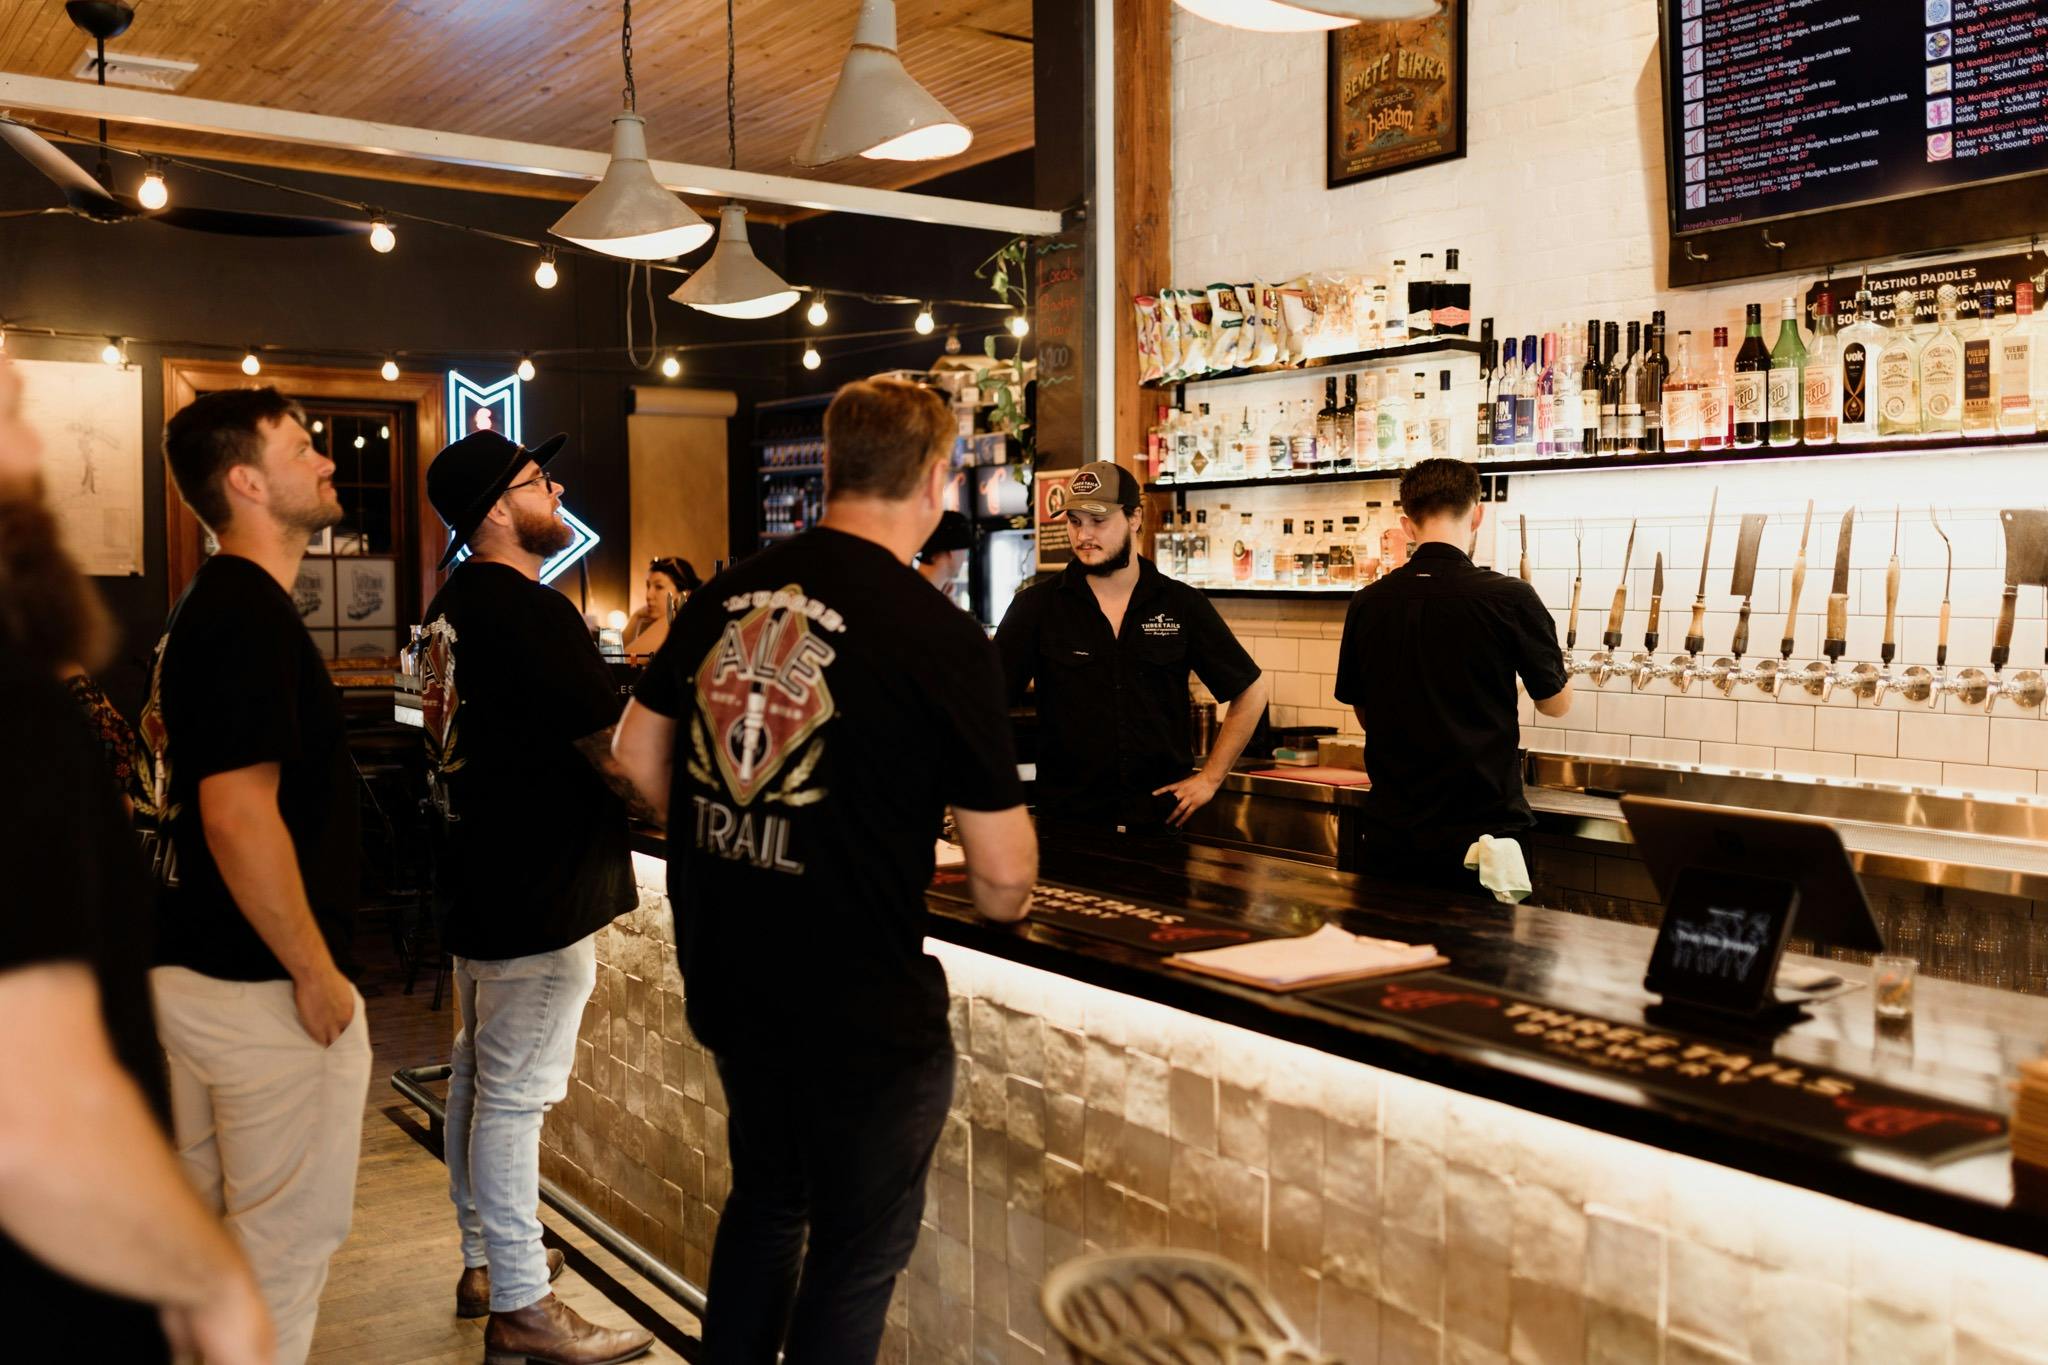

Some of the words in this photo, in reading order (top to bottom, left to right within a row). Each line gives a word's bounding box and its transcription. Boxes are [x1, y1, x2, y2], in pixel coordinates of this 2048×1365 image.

[1955, 2, 1967, 11] IPA
[1955, 9, 1977, 20] Middy
[1979, 6, 1988, 15] $9
[1993, 0, 2028, 11] Schooner
[1787, 28, 1810, 38] Mudgee,
[1811, 24, 1824, 32] New
[1824, 19, 1841, 28] South
[1842, 15, 1860, 23] Wales
[1955, 27, 1965, 35] 18.
[1967, 23, 1985, 33] Bach
[2011, 12, 2036, 22] Marley
[1955, 35, 1974, 45] Stout
[1981, 28, 2005, 39] cherry
[2006, 24, 2024, 33] choc
[1955, 44, 1977, 54] Middy
[1979, 40, 1990, 50] $11
[1996, 32, 2031, 45] Schooner
[2034, 28, 2047, 37] $14
[1397, 49, 1446, 80] BIRRA
[1778, 59, 1801, 68] Mudgee,
[1815, 50, 1832, 60] South
[1833, 47, 1851, 55] Wales
[1955, 62, 1965, 70] 19.
[1966, 56, 1993, 67] Nomad
[2024, 47, 2038, 55] Day
[1955, 69, 1974, 79] Stout
[1980, 61, 2010, 73] Imperial
[2018, 54, 2044, 65] Double
[1955, 78, 1977, 88] Middy
[1979, 75, 1988, 84] $9
[1994, 68, 2029, 80] Schooner
[2031, 63, 2044, 73] $12
[1765, 91, 1787, 100] Mudgee,
[1801, 83, 1818, 92] South
[1819, 80, 1836, 88] Wales
[1956, 96, 1966, 105] 20.
[1968, 87, 2015, 101] Morningcider
[1832, 105, 1856, 114] Mudgee,
[1871, 97, 1889, 106] South
[1889, 93, 1907, 102] Wales
[1955, 105, 1974, 114] Cider
[2006, 94, 2023, 104] 4.9%
[2025, 91, 2040, 100] ABV
[1955, 113, 1978, 123] Middy
[1979, 108, 1998, 119] $9.50
[2004, 101, 2039, 113] Schooner
[1367, 103, 1414, 141] baladin
[1956, 131, 1965, 139] 21.
[1967, 125, 1993, 136] Nomad
[1994, 121, 2015, 131] Good
[1790, 144, 1801, 152] ABV
[1805, 140, 1828, 149] Mudgee,
[1843, 132, 1860, 141] South
[1956, 139, 1976, 148] Other
[1982, 134, 2000, 143] 4.5%
[2001, 130, 2016, 139] ABV
[1956, 148, 1978, 157] Middy
[1979, 145, 1989, 154] $8
[1995, 139, 2029, 150] Schooner
[2032, 135, 2044, 144] $11
[1804, 169, 1828, 177] Mudgee,
[1843, 162, 1860, 171] South
[1861, 159, 1878, 167] Wales
[1868, 275, 1918, 292] TASTING
[1920, 268, 1977, 285] PADDLES
[1913, 289, 1935, 301] EER
[1955, 279, 2011, 296] KE-AWAY
[1846, 350, 1864, 362] vok
[712, 619, 837, 706] ALE
[692, 795, 805, 876] TRAIL
